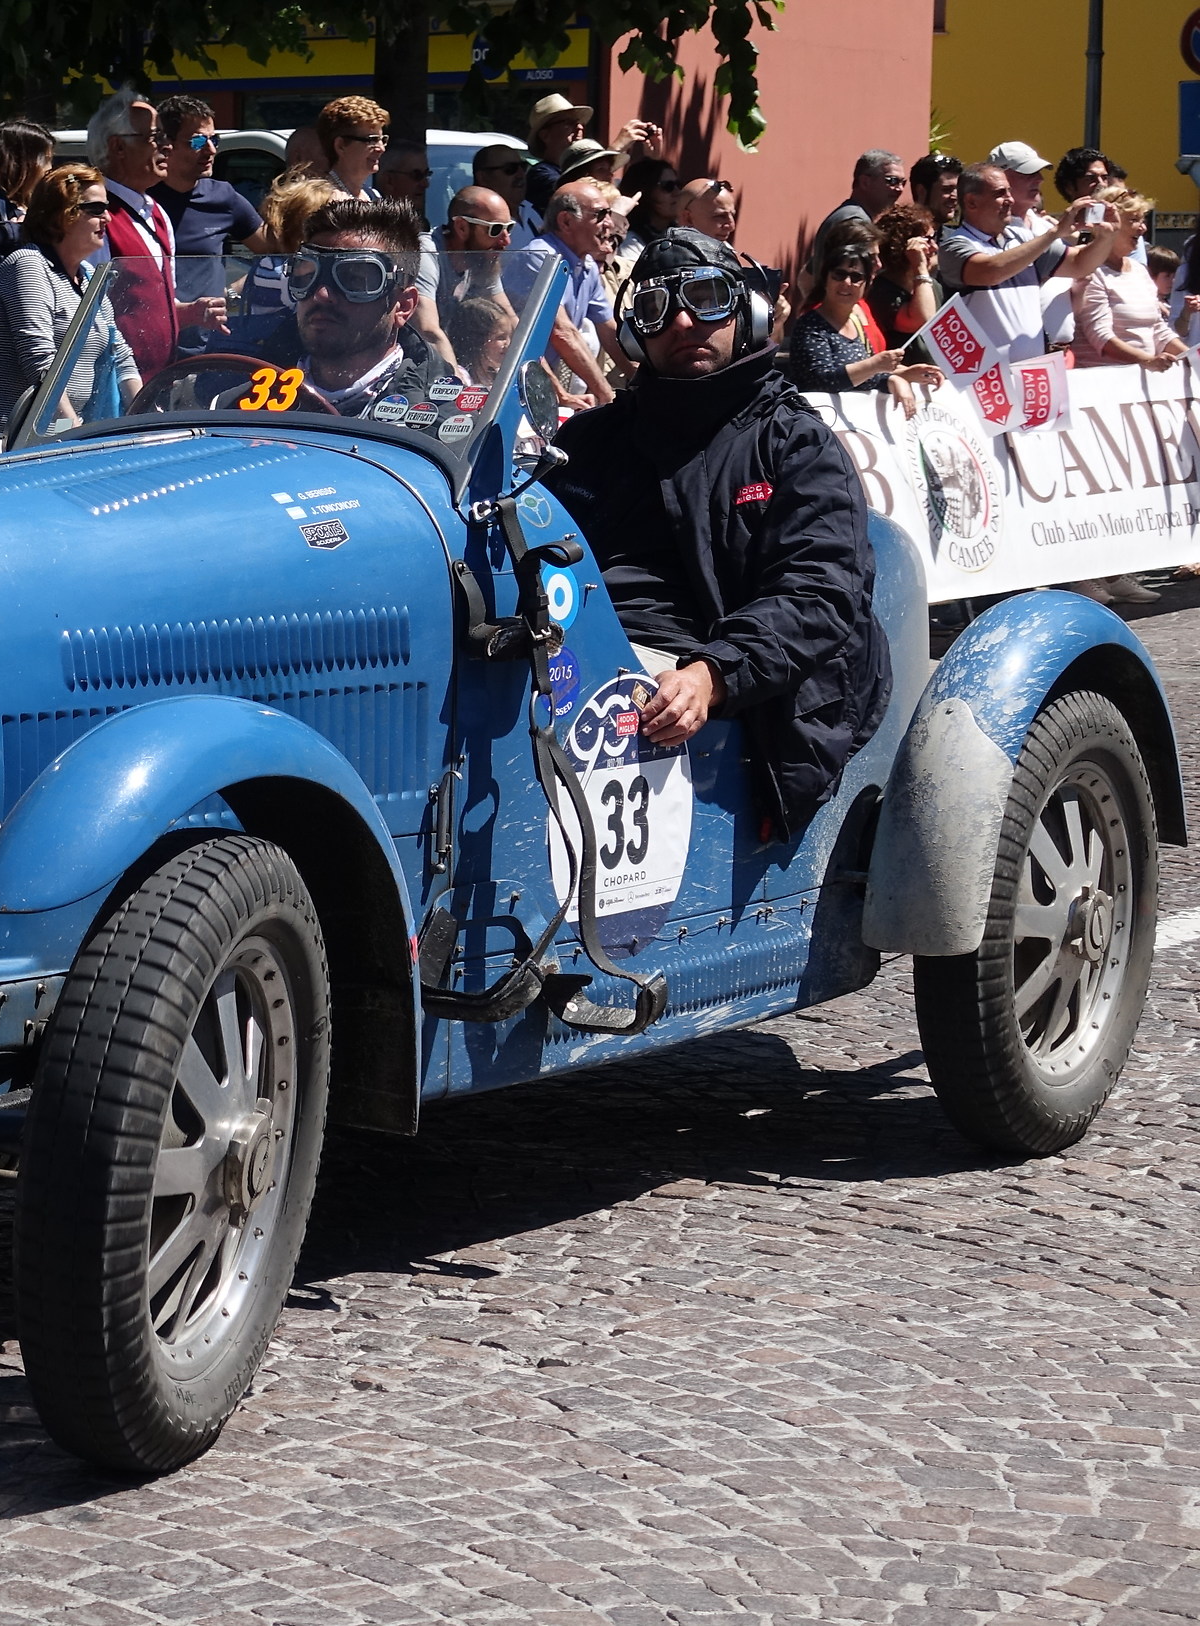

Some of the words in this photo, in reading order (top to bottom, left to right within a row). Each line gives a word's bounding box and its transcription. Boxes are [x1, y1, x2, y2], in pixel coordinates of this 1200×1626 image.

[525, 69, 554, 80] ALOISIO
[932, 324, 965, 368] MIGLIA
[946, 314, 975, 353] 1000
[239, 367, 305, 412] 33
[460, 395, 484, 404] 2015
[974, 380, 995, 415] GLIA
[986, 367, 1006, 405] 000
[1037, 374, 1049, 419] 1000
[406, 412, 436, 422] VERIFICATO
[442, 424, 471, 433] VERIFICATO
[738, 485, 763, 496] 1000
[1031, 521, 1065, 547] Club
[1068, 518, 1098, 542] Auto
[1098, 512, 1134, 538] Moto
[1136, 507, 1183, 536] d'Epoca
[949, 535, 995, 568] CAMEB
[549, 664, 573, 682] 2015
[599, 774, 650, 870] 33
[604, 870, 647, 888] CHOPARD
